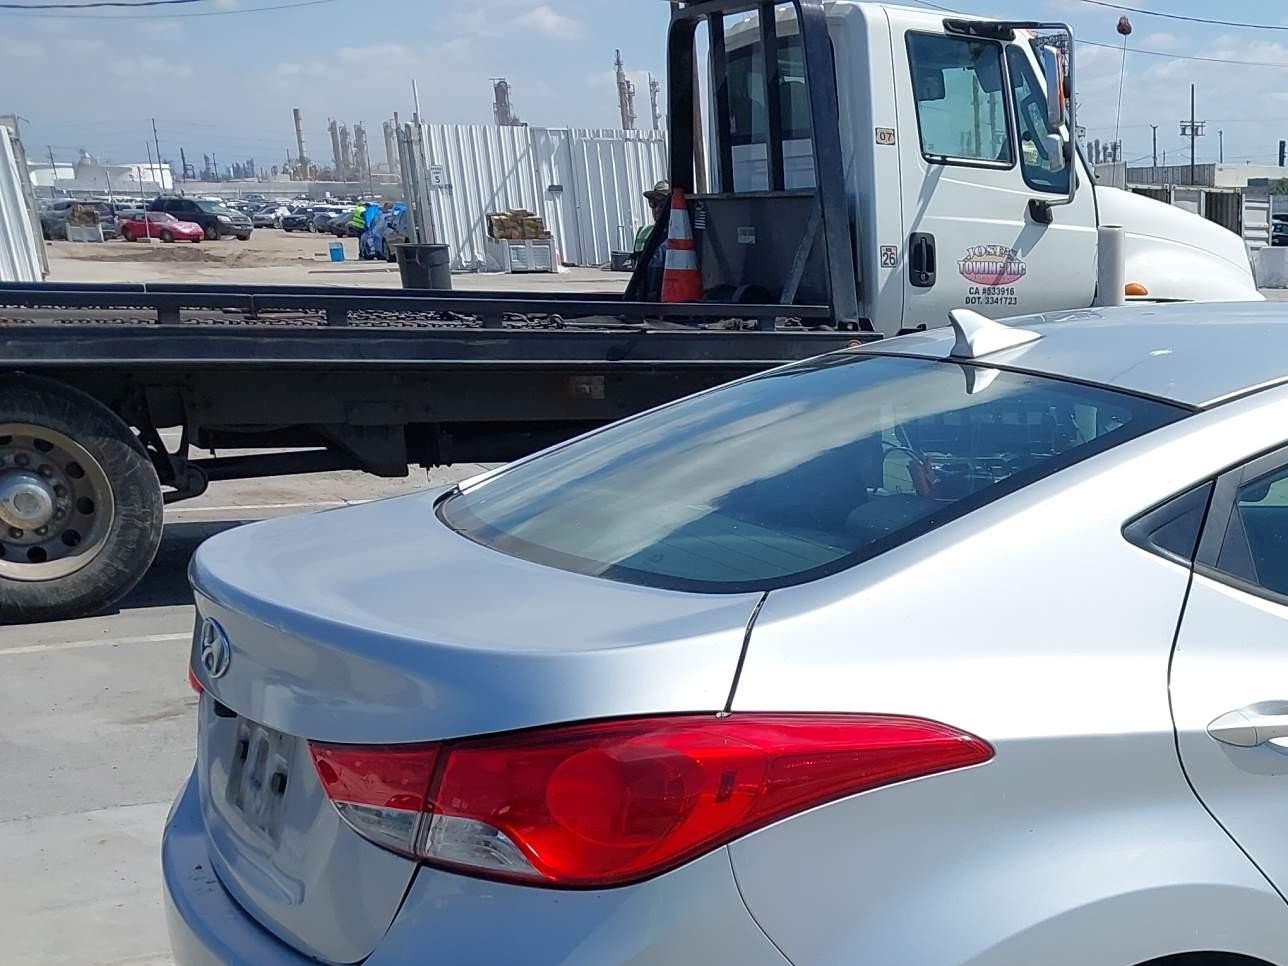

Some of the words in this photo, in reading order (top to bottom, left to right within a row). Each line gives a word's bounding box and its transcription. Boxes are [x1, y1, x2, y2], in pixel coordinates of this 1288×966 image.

[879, 132, 892, 141] 07
[883, 252, 896, 265] 26
[957, 260, 1005, 275] TOWING
[1006, 261, 1027, 276] INC
[968, 286, 980, 295] CA
[965, 296, 983, 305] DOT.
[985, 296, 1018, 305] 3341723
